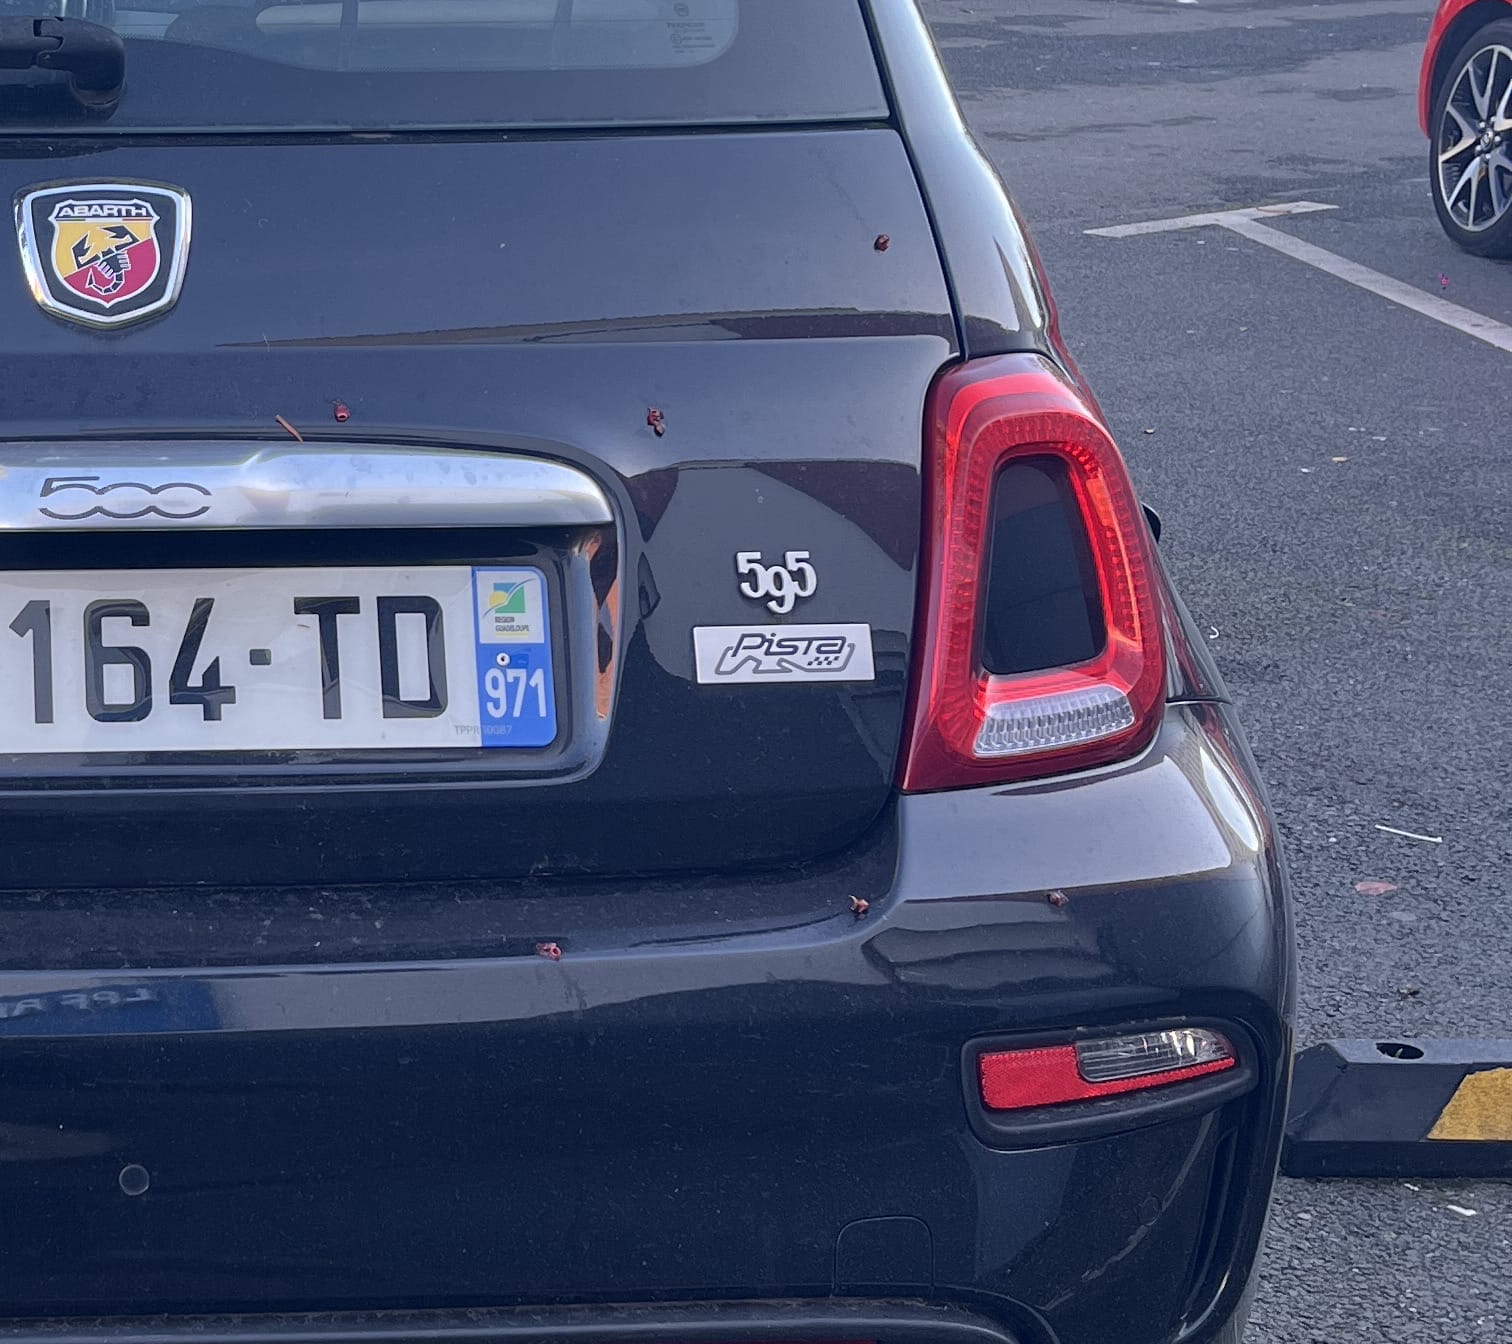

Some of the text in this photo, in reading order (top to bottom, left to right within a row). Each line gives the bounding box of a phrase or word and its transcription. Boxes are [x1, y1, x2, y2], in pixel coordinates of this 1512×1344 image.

[59, 206, 147, 218] ABARTH
[39, 476, 212, 520] 500
[736, 550, 817, 614] 595
[485, 668, 548, 718] 971
